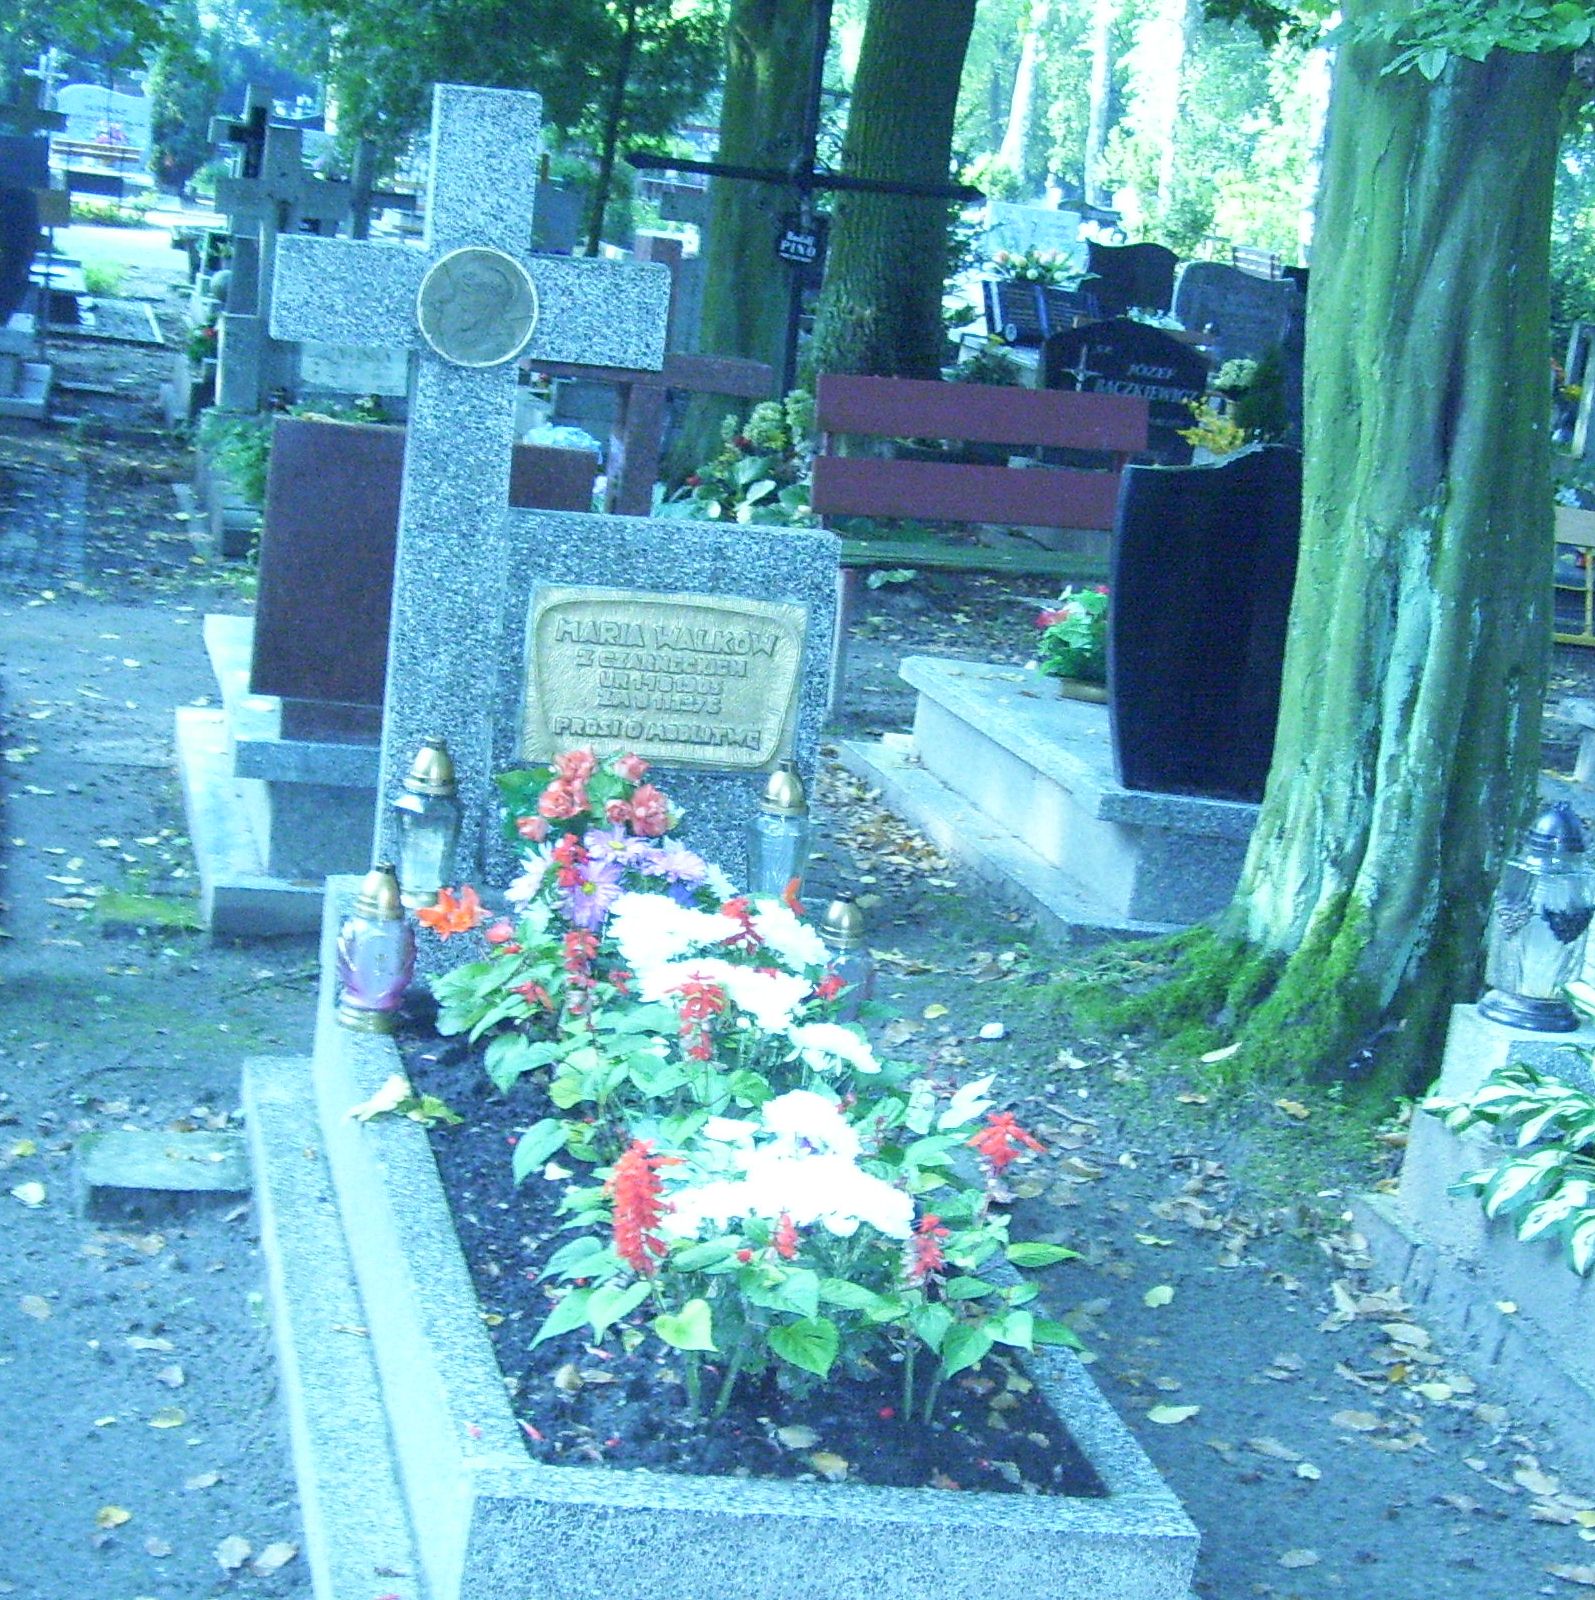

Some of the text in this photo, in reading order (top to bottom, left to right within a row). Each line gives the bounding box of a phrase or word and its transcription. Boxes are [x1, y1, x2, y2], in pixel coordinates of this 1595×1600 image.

[555, 618, 645, 648] MARIA
[575, 649, 595, 667] Z
[554, 716, 621, 738] PROSI
[626, 720, 643, 740] O
